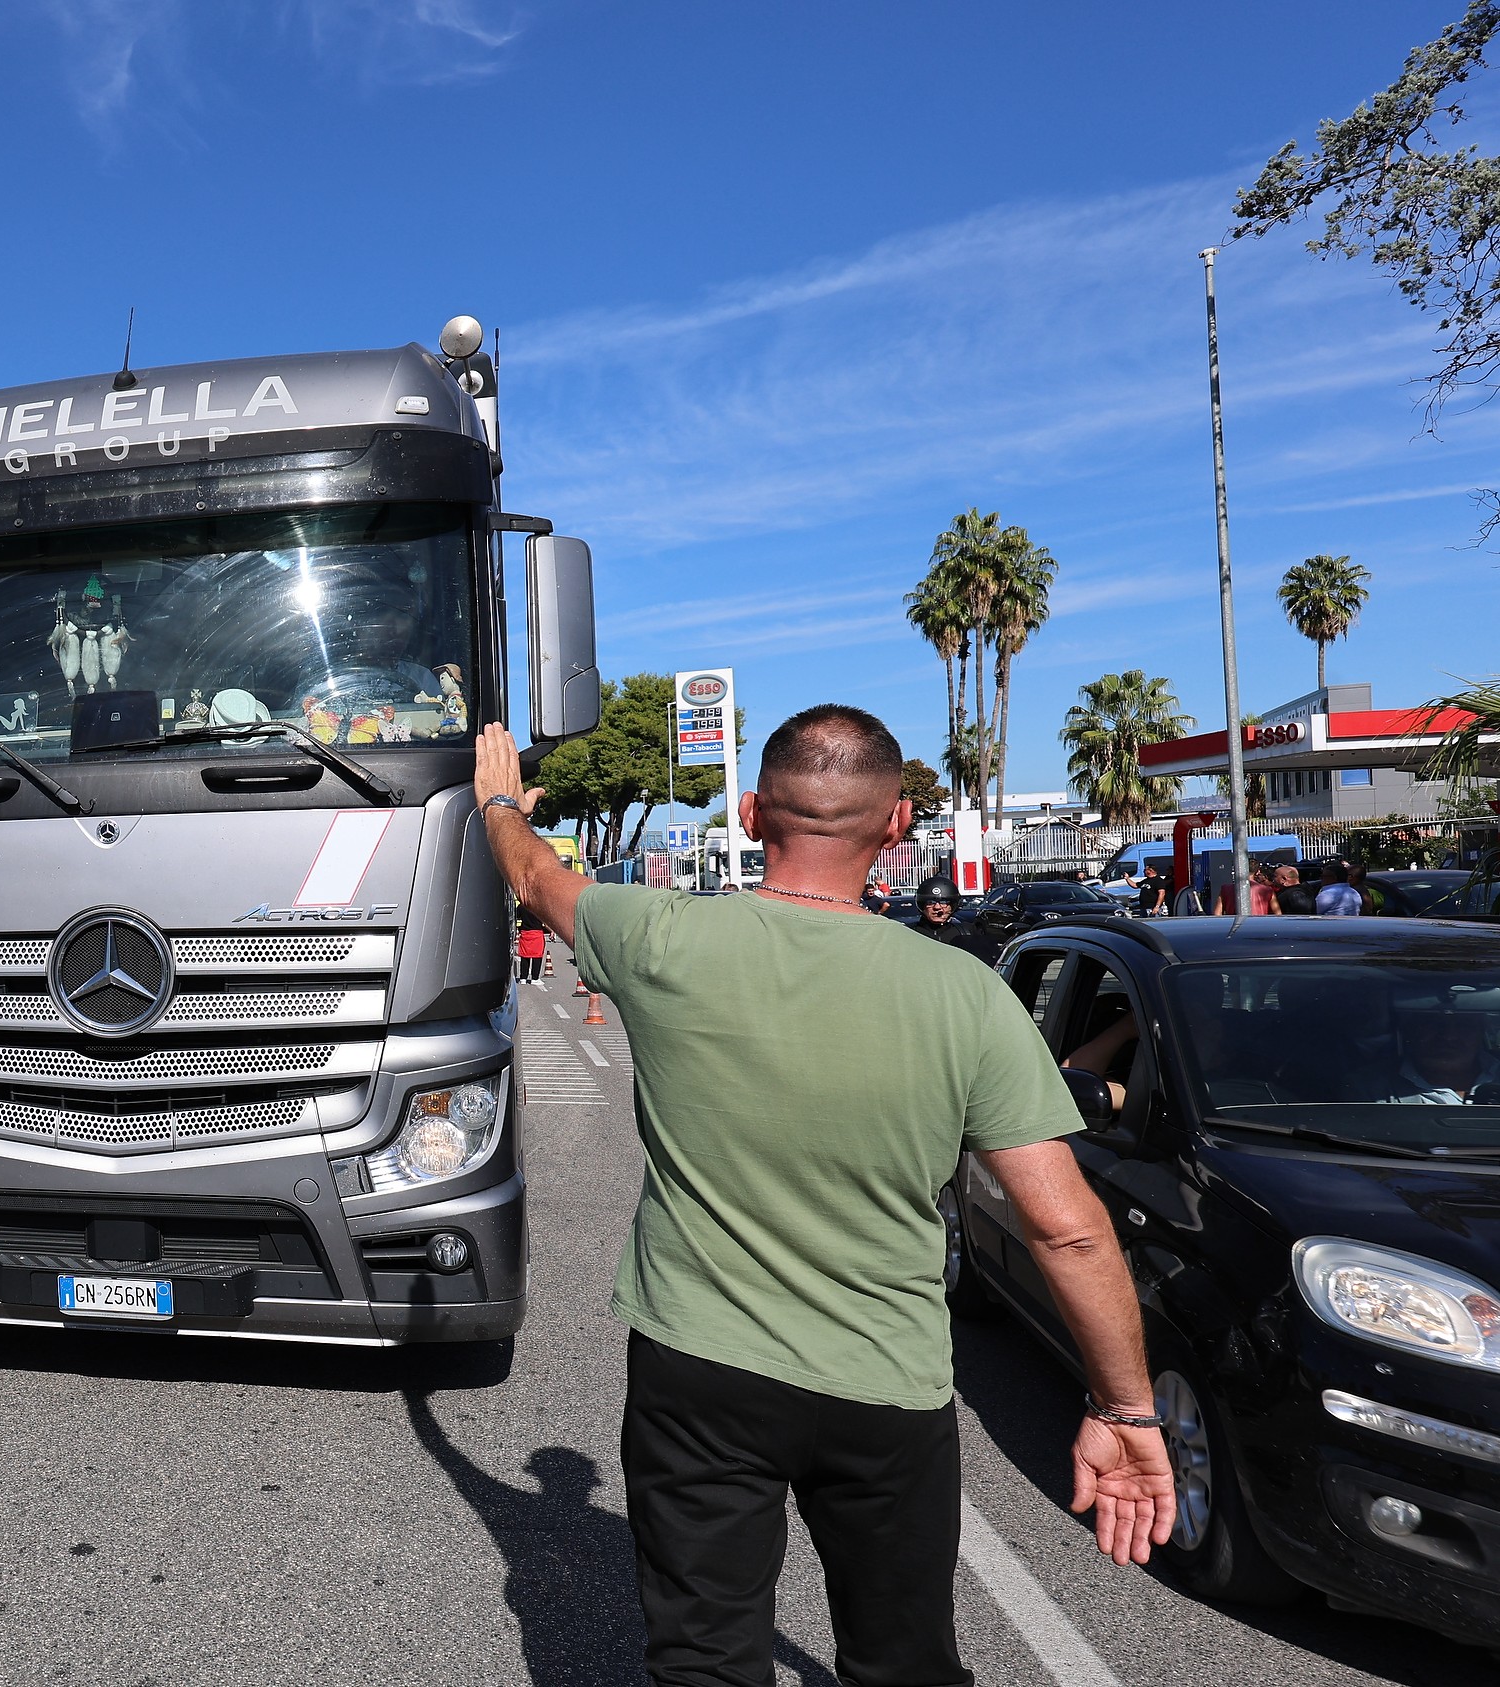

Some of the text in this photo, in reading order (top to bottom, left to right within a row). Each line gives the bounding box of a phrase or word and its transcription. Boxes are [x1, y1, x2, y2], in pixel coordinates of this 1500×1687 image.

[4, 427, 231, 474] GROUP
[682, 743, 722, 752] Bar-Tabacchi
[1254, 722, 1299, 748] ESSO
[367, 903, 399, 920] F
[75, 1283, 156, 1308] GN 256RN
